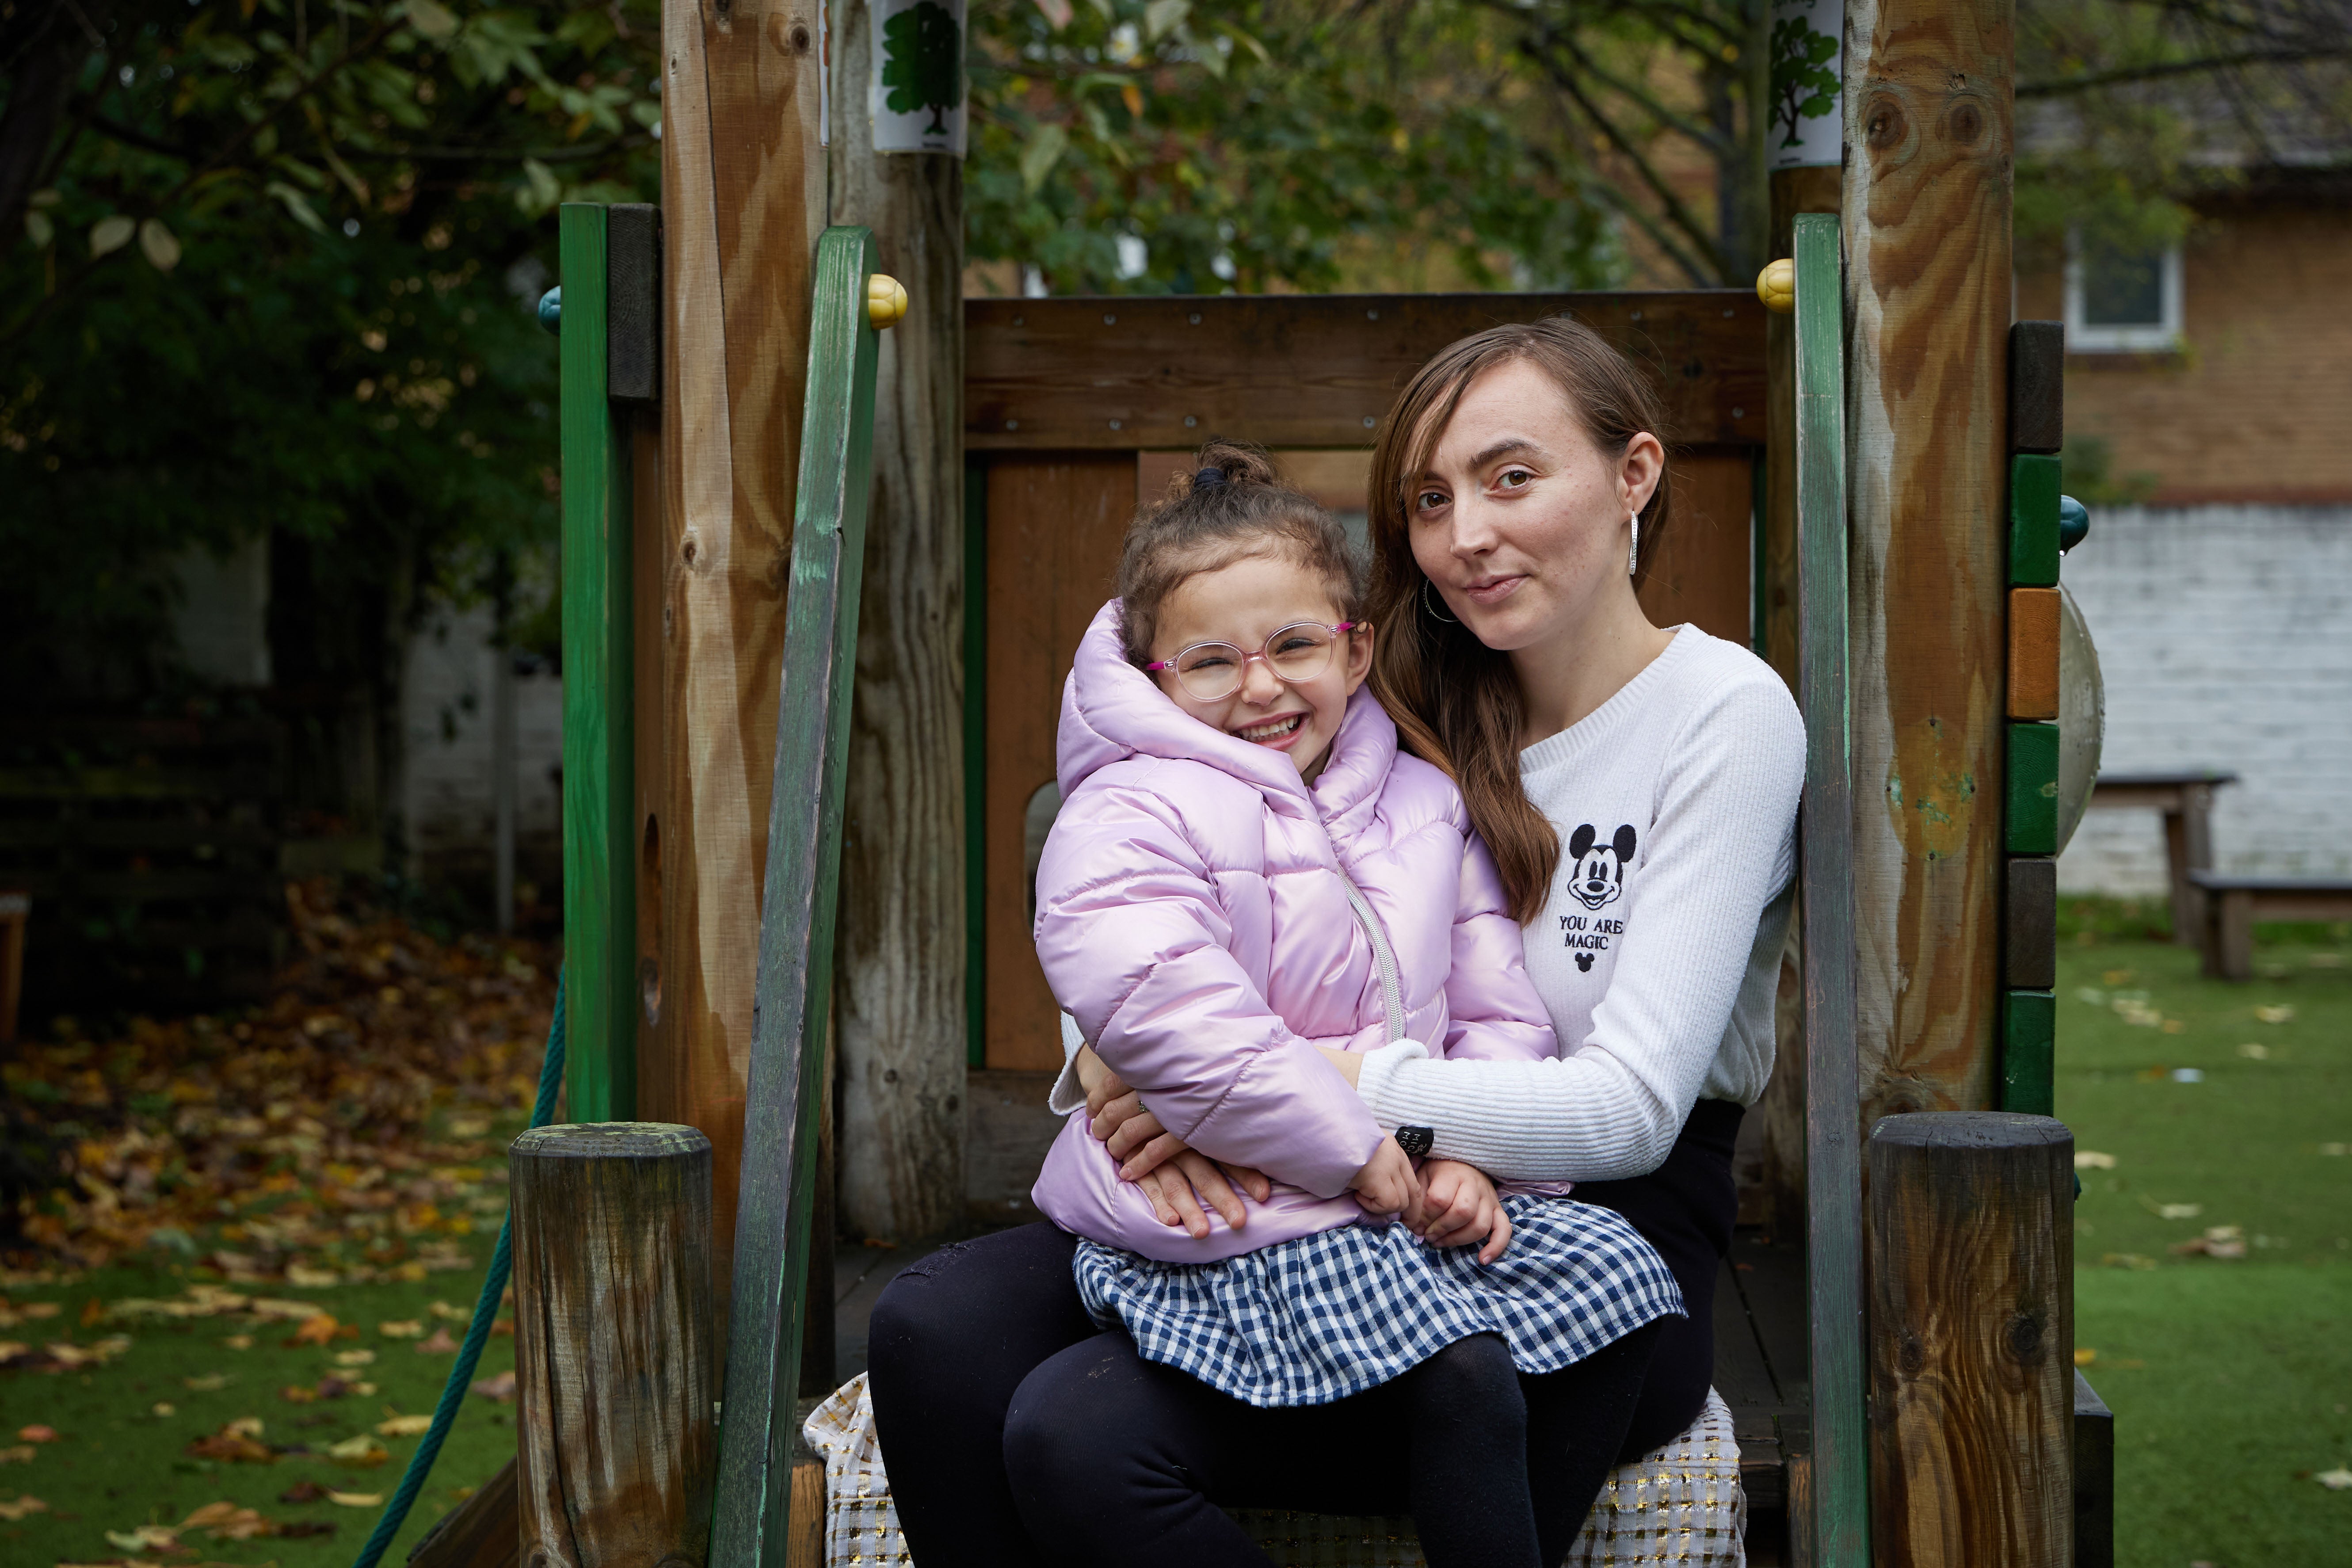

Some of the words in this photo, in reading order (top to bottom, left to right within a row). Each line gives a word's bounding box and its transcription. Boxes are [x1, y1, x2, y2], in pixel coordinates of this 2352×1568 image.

[1559, 916, 1587, 931] YOU
[1593, 919, 1623, 934] ARE
[1565, 934, 1609, 950] MAGIC
